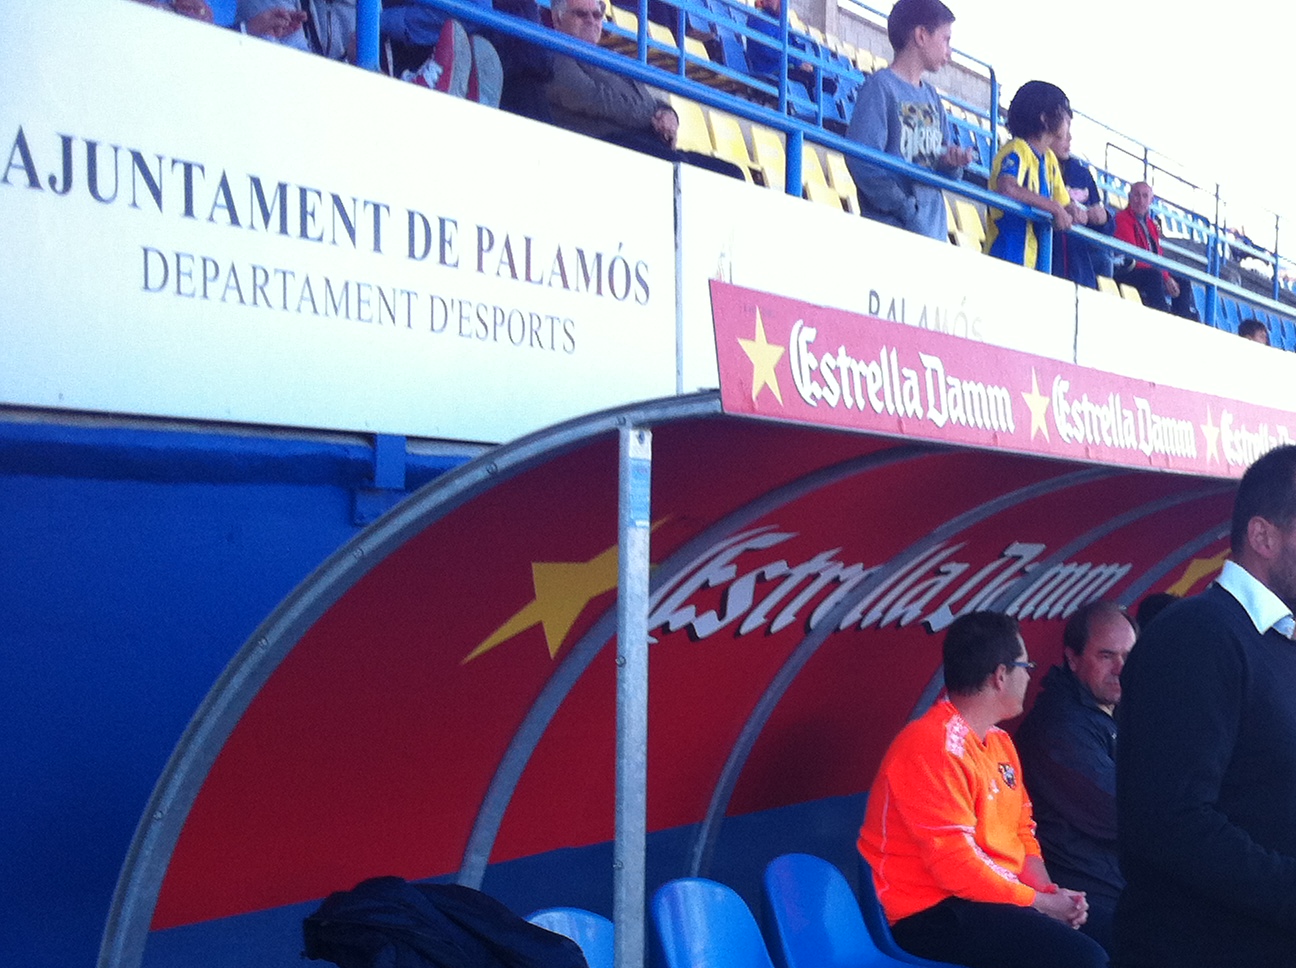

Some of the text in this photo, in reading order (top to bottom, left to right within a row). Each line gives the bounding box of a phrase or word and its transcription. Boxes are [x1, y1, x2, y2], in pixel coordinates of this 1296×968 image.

[1, 124, 651, 306] AJUNTAMENT DE PALAMÓS
[140, 246, 577, 355] DEPARTAMENT D'ESPORTS
[789, 319, 1015, 434] Estrella Damm
[1052, 374, 1197, 459] Estrella Damm
